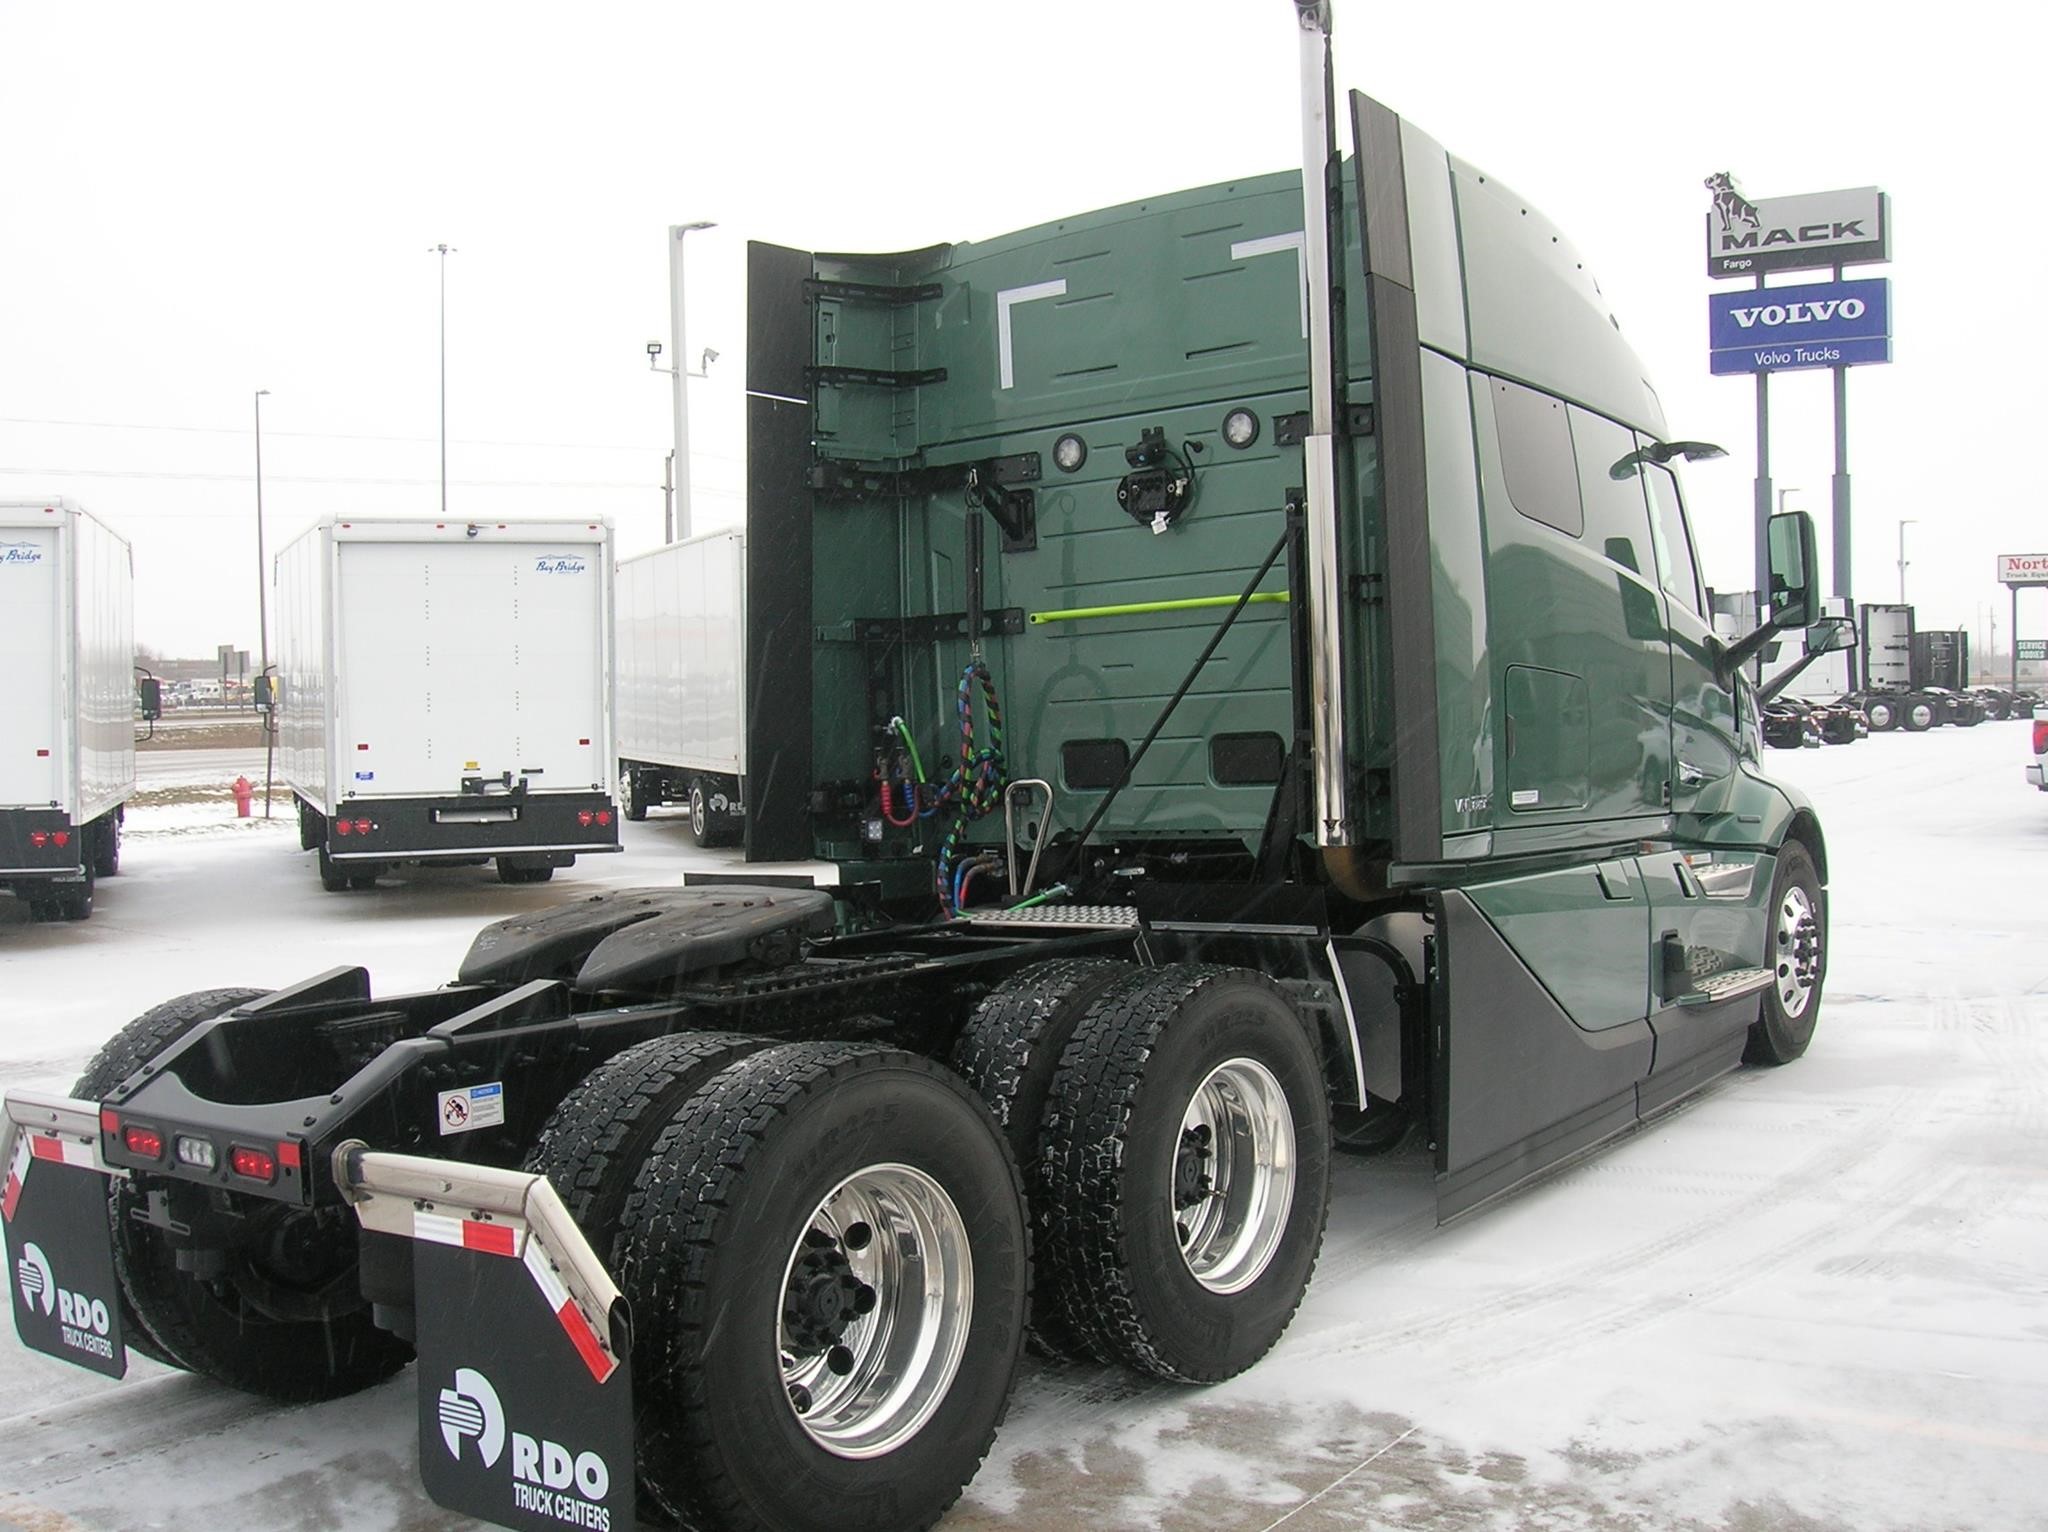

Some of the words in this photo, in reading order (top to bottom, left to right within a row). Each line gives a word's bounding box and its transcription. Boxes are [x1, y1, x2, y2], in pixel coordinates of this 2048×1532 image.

[1722, 220, 1865, 250] MACK
[1723, 259, 1752, 270] Fargo
[1730, 298, 1865, 328] VOLVO
[1755, 351, 1791, 366] Volvo
[1794, 347, 1840, 362] Trucks
[536, 560, 554, 574] Bay
[555, 560, 585, 574] Bridge
[2008, 558, 2048, 570] Nort
[2018, 641, 2047, 650] SERVICE
[58, 1288, 110, 1336] RDO
[62, 1325, 85, 1350] TRUCK
[83, 1332, 113, 1359] CENTERS
[512, 1431, 609, 1500] RDO
[513, 1481, 553, 1516] TRUCK
[555, 1494, 611, 1532] CENTERS
